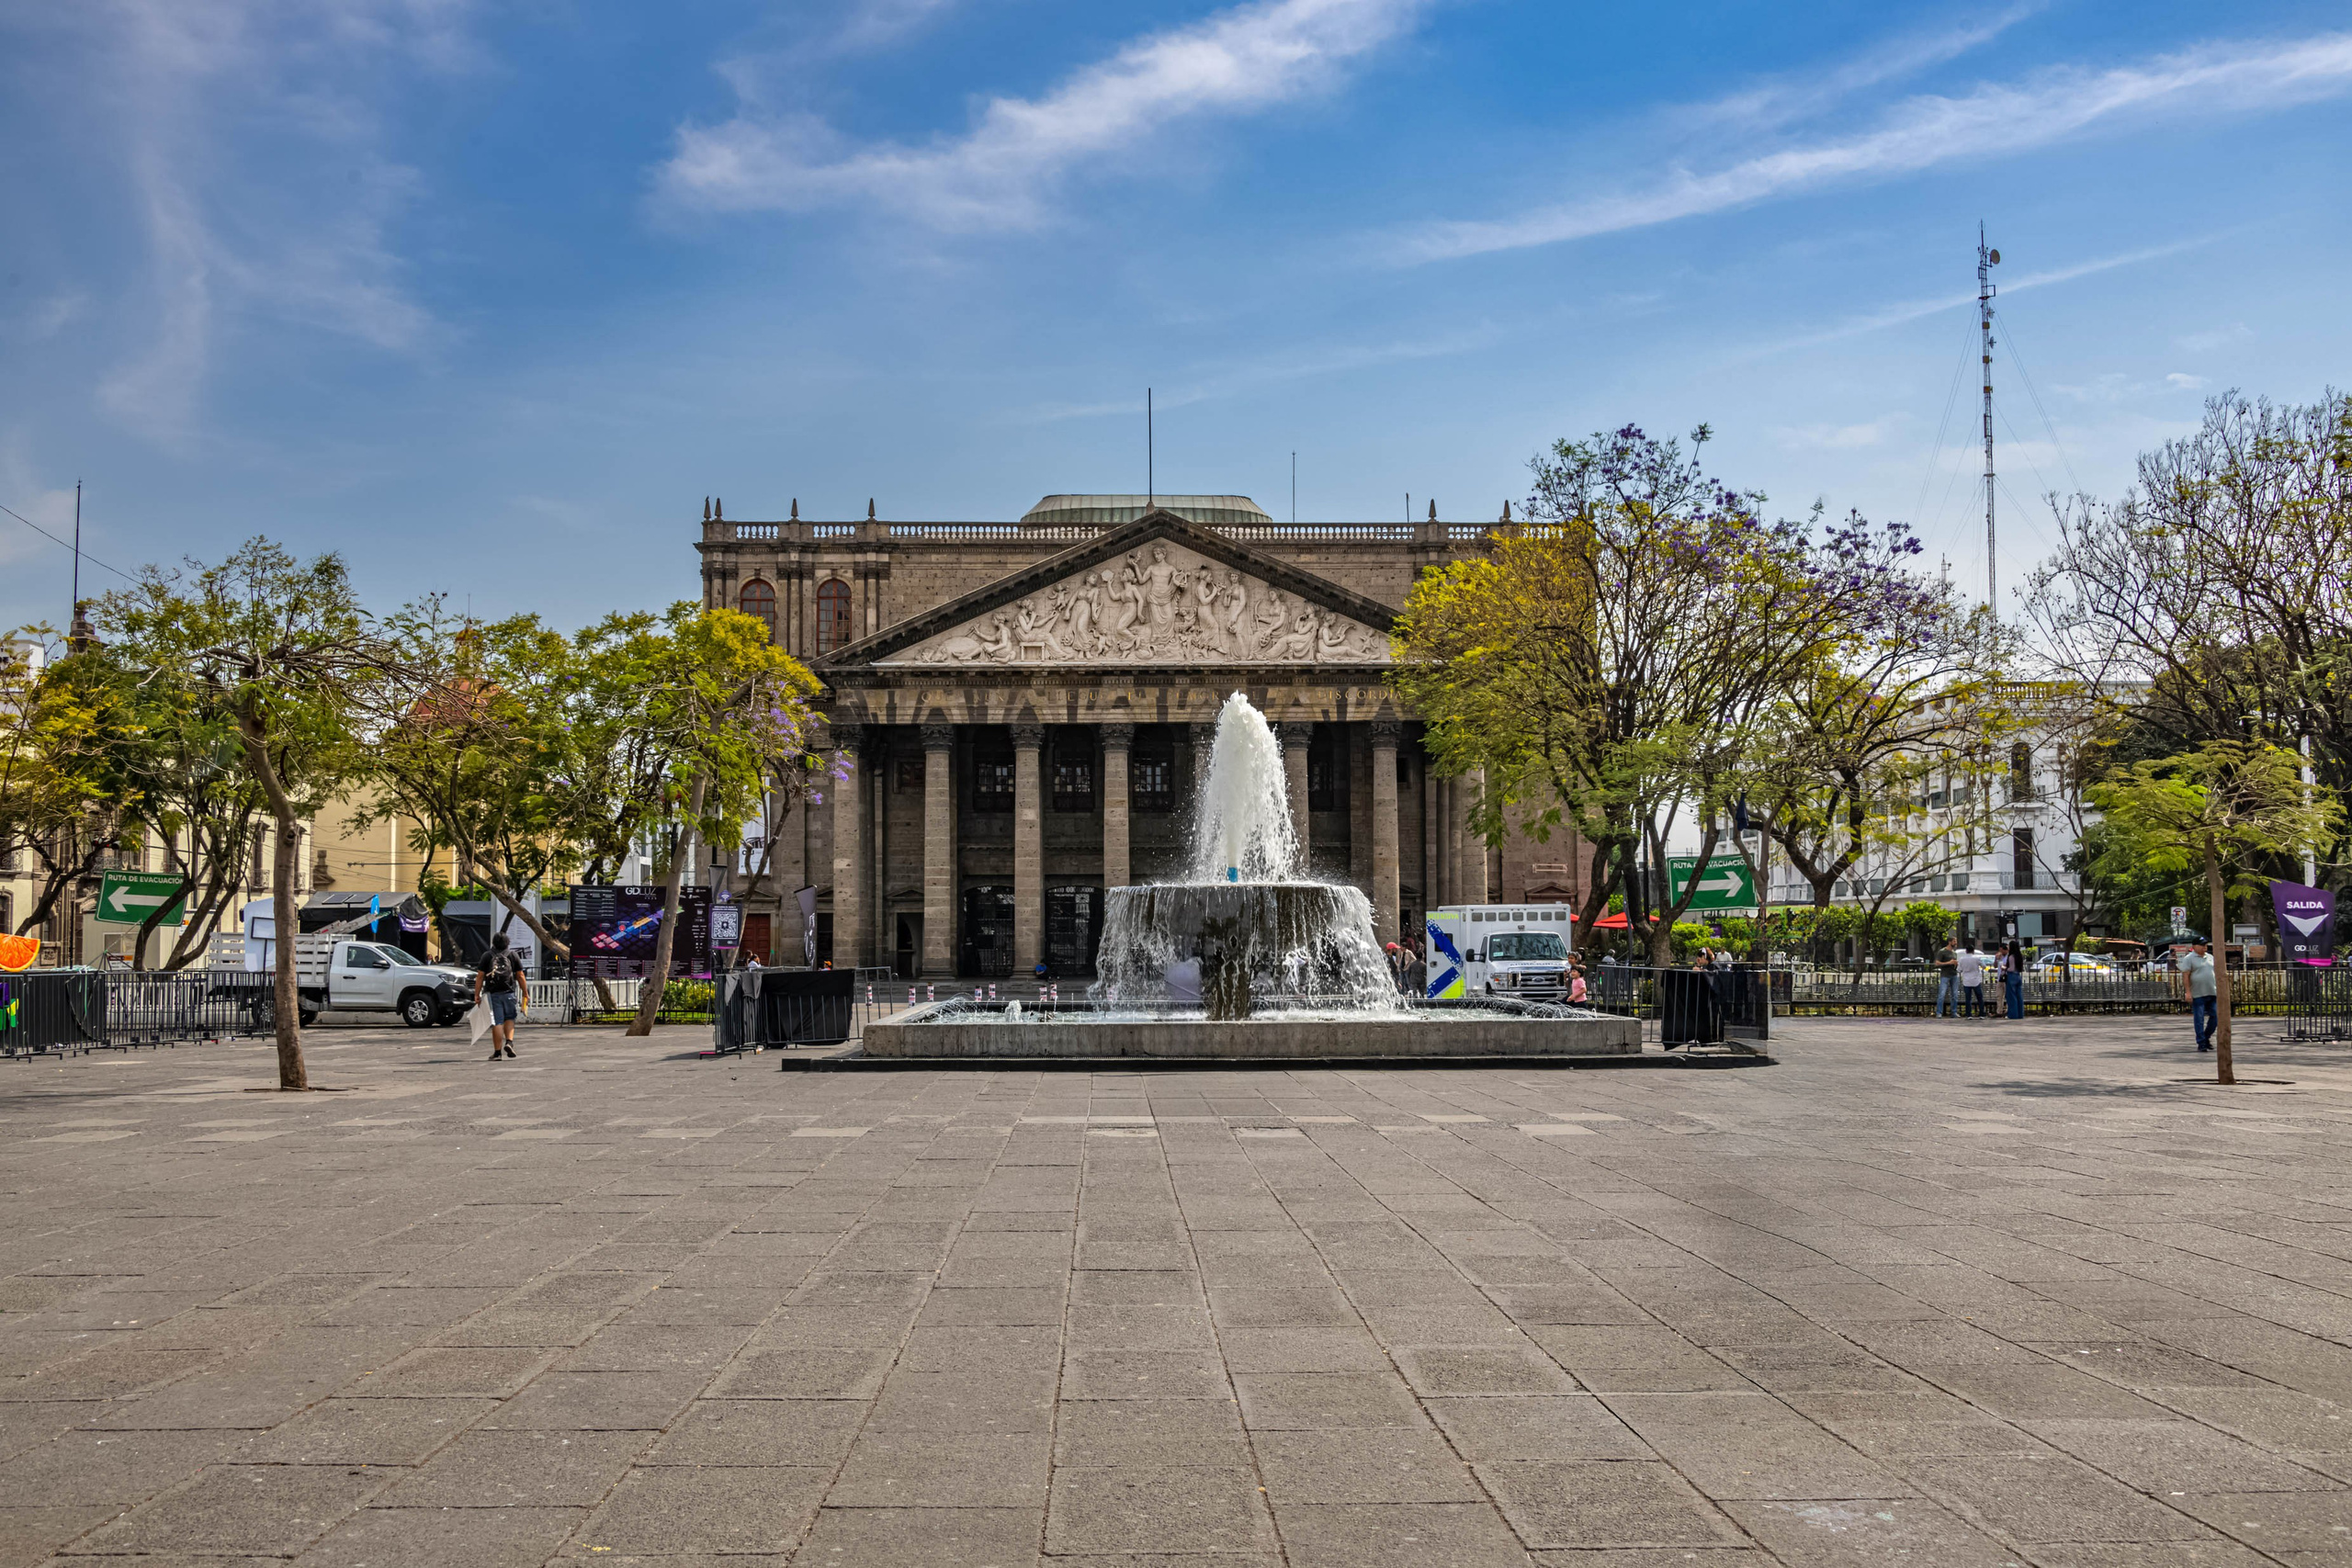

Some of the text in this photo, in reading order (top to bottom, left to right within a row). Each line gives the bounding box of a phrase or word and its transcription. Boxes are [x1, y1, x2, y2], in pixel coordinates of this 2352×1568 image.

[1706, 858, 1747, 868] VACUACIÓ
[107, 874, 127, 882] RUTA
[625, 886, 656, 896] GDLUZ
[2286, 901, 2324, 909] SALIDA
